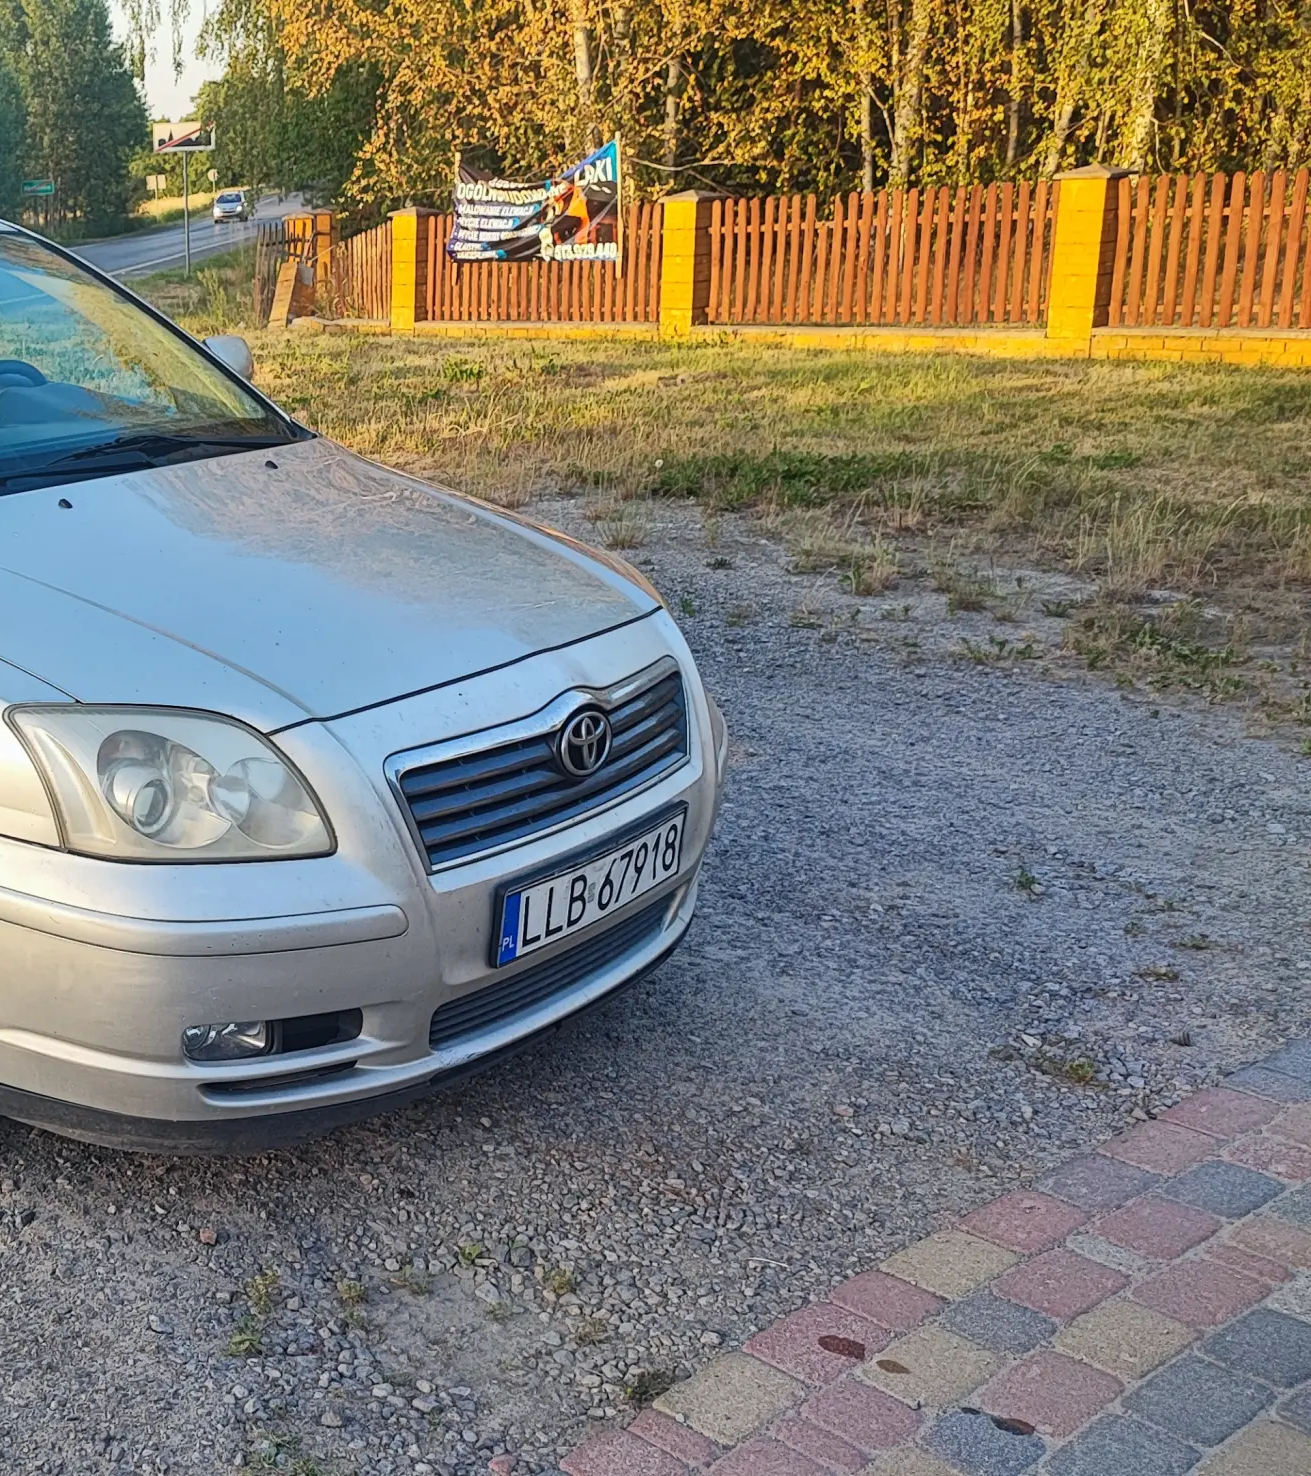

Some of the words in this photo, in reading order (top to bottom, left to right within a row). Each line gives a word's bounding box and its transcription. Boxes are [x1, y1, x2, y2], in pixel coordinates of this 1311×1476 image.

[522, 874, 588, 948] LLB
[597, 823, 678, 911] 67918
[501, 934, 515, 952] PL
